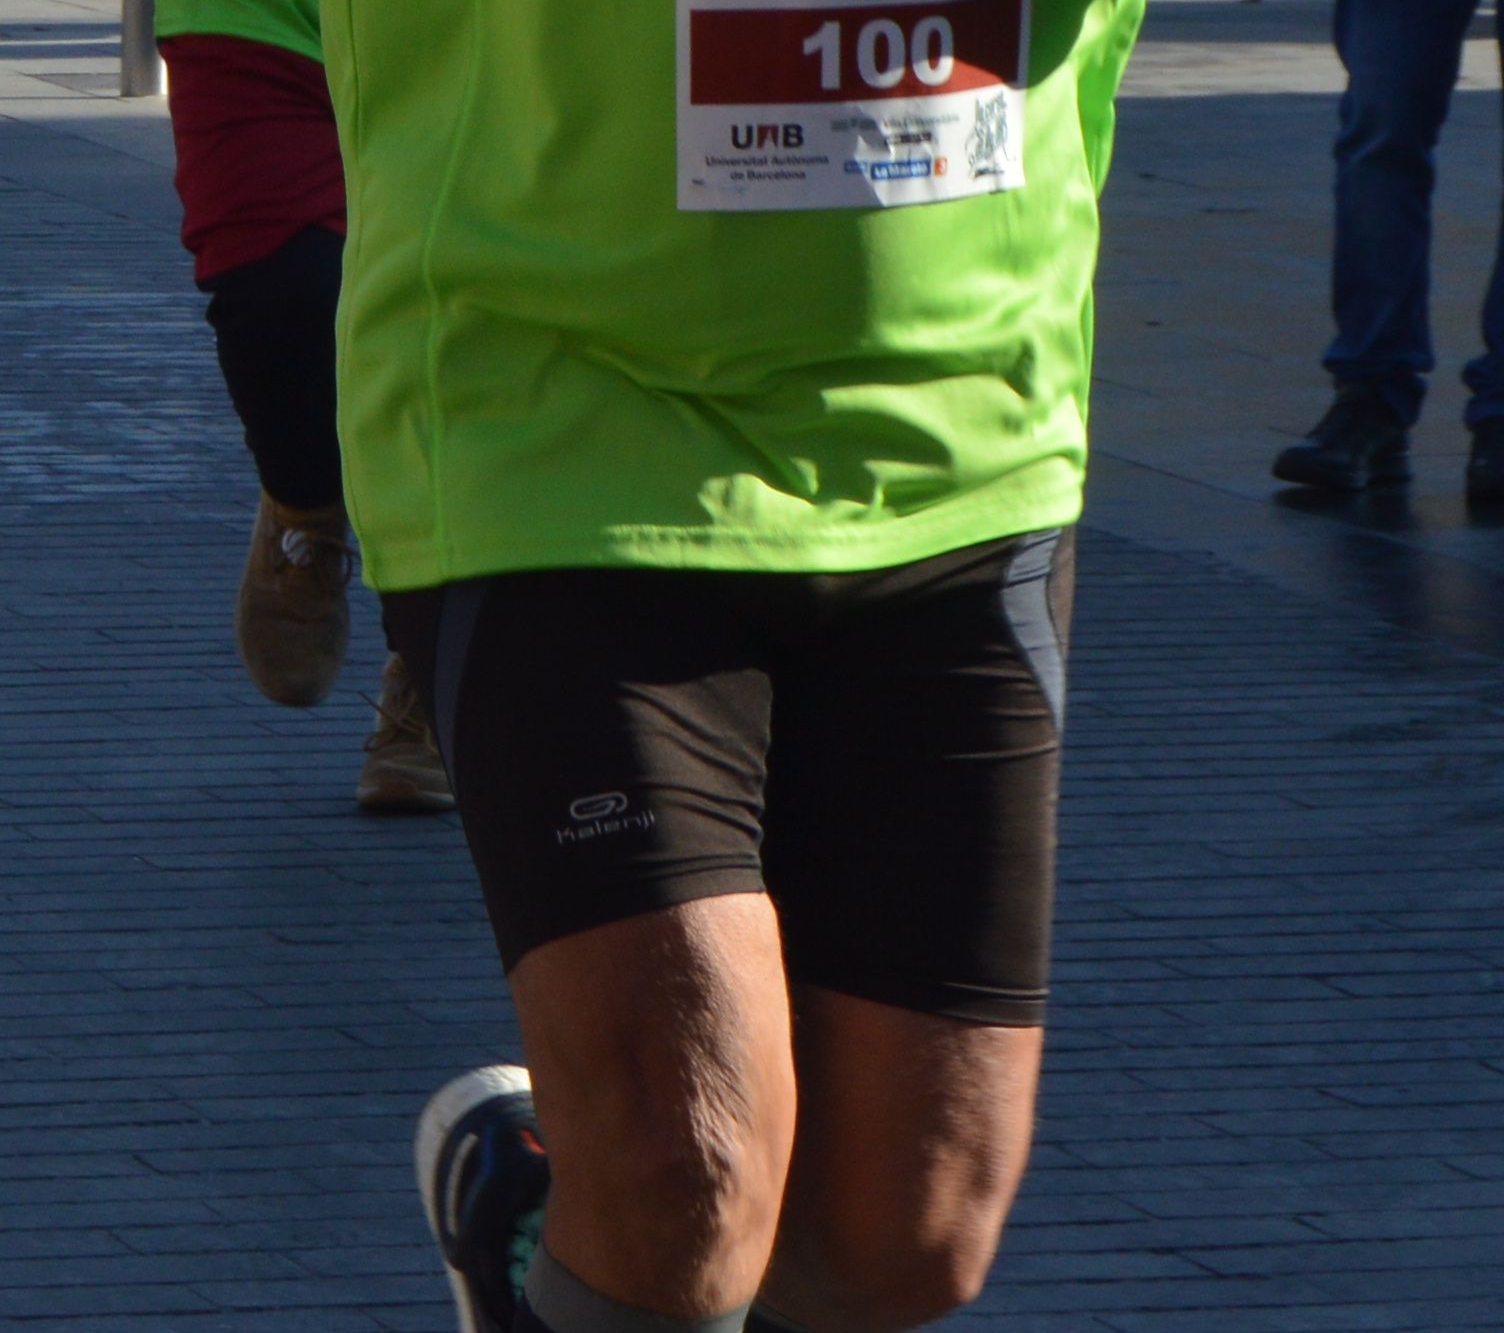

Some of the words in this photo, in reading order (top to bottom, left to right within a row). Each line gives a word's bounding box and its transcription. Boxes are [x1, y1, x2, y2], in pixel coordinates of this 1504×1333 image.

[802, 14, 956, 92] 100
[731, 123, 804, 150] UAB
[705, 154, 768, 167] Universitat
[730, 169, 744, 181] de
[747, 169, 806, 181] Barcelona
[554, 810, 656, 845] Kalenji
